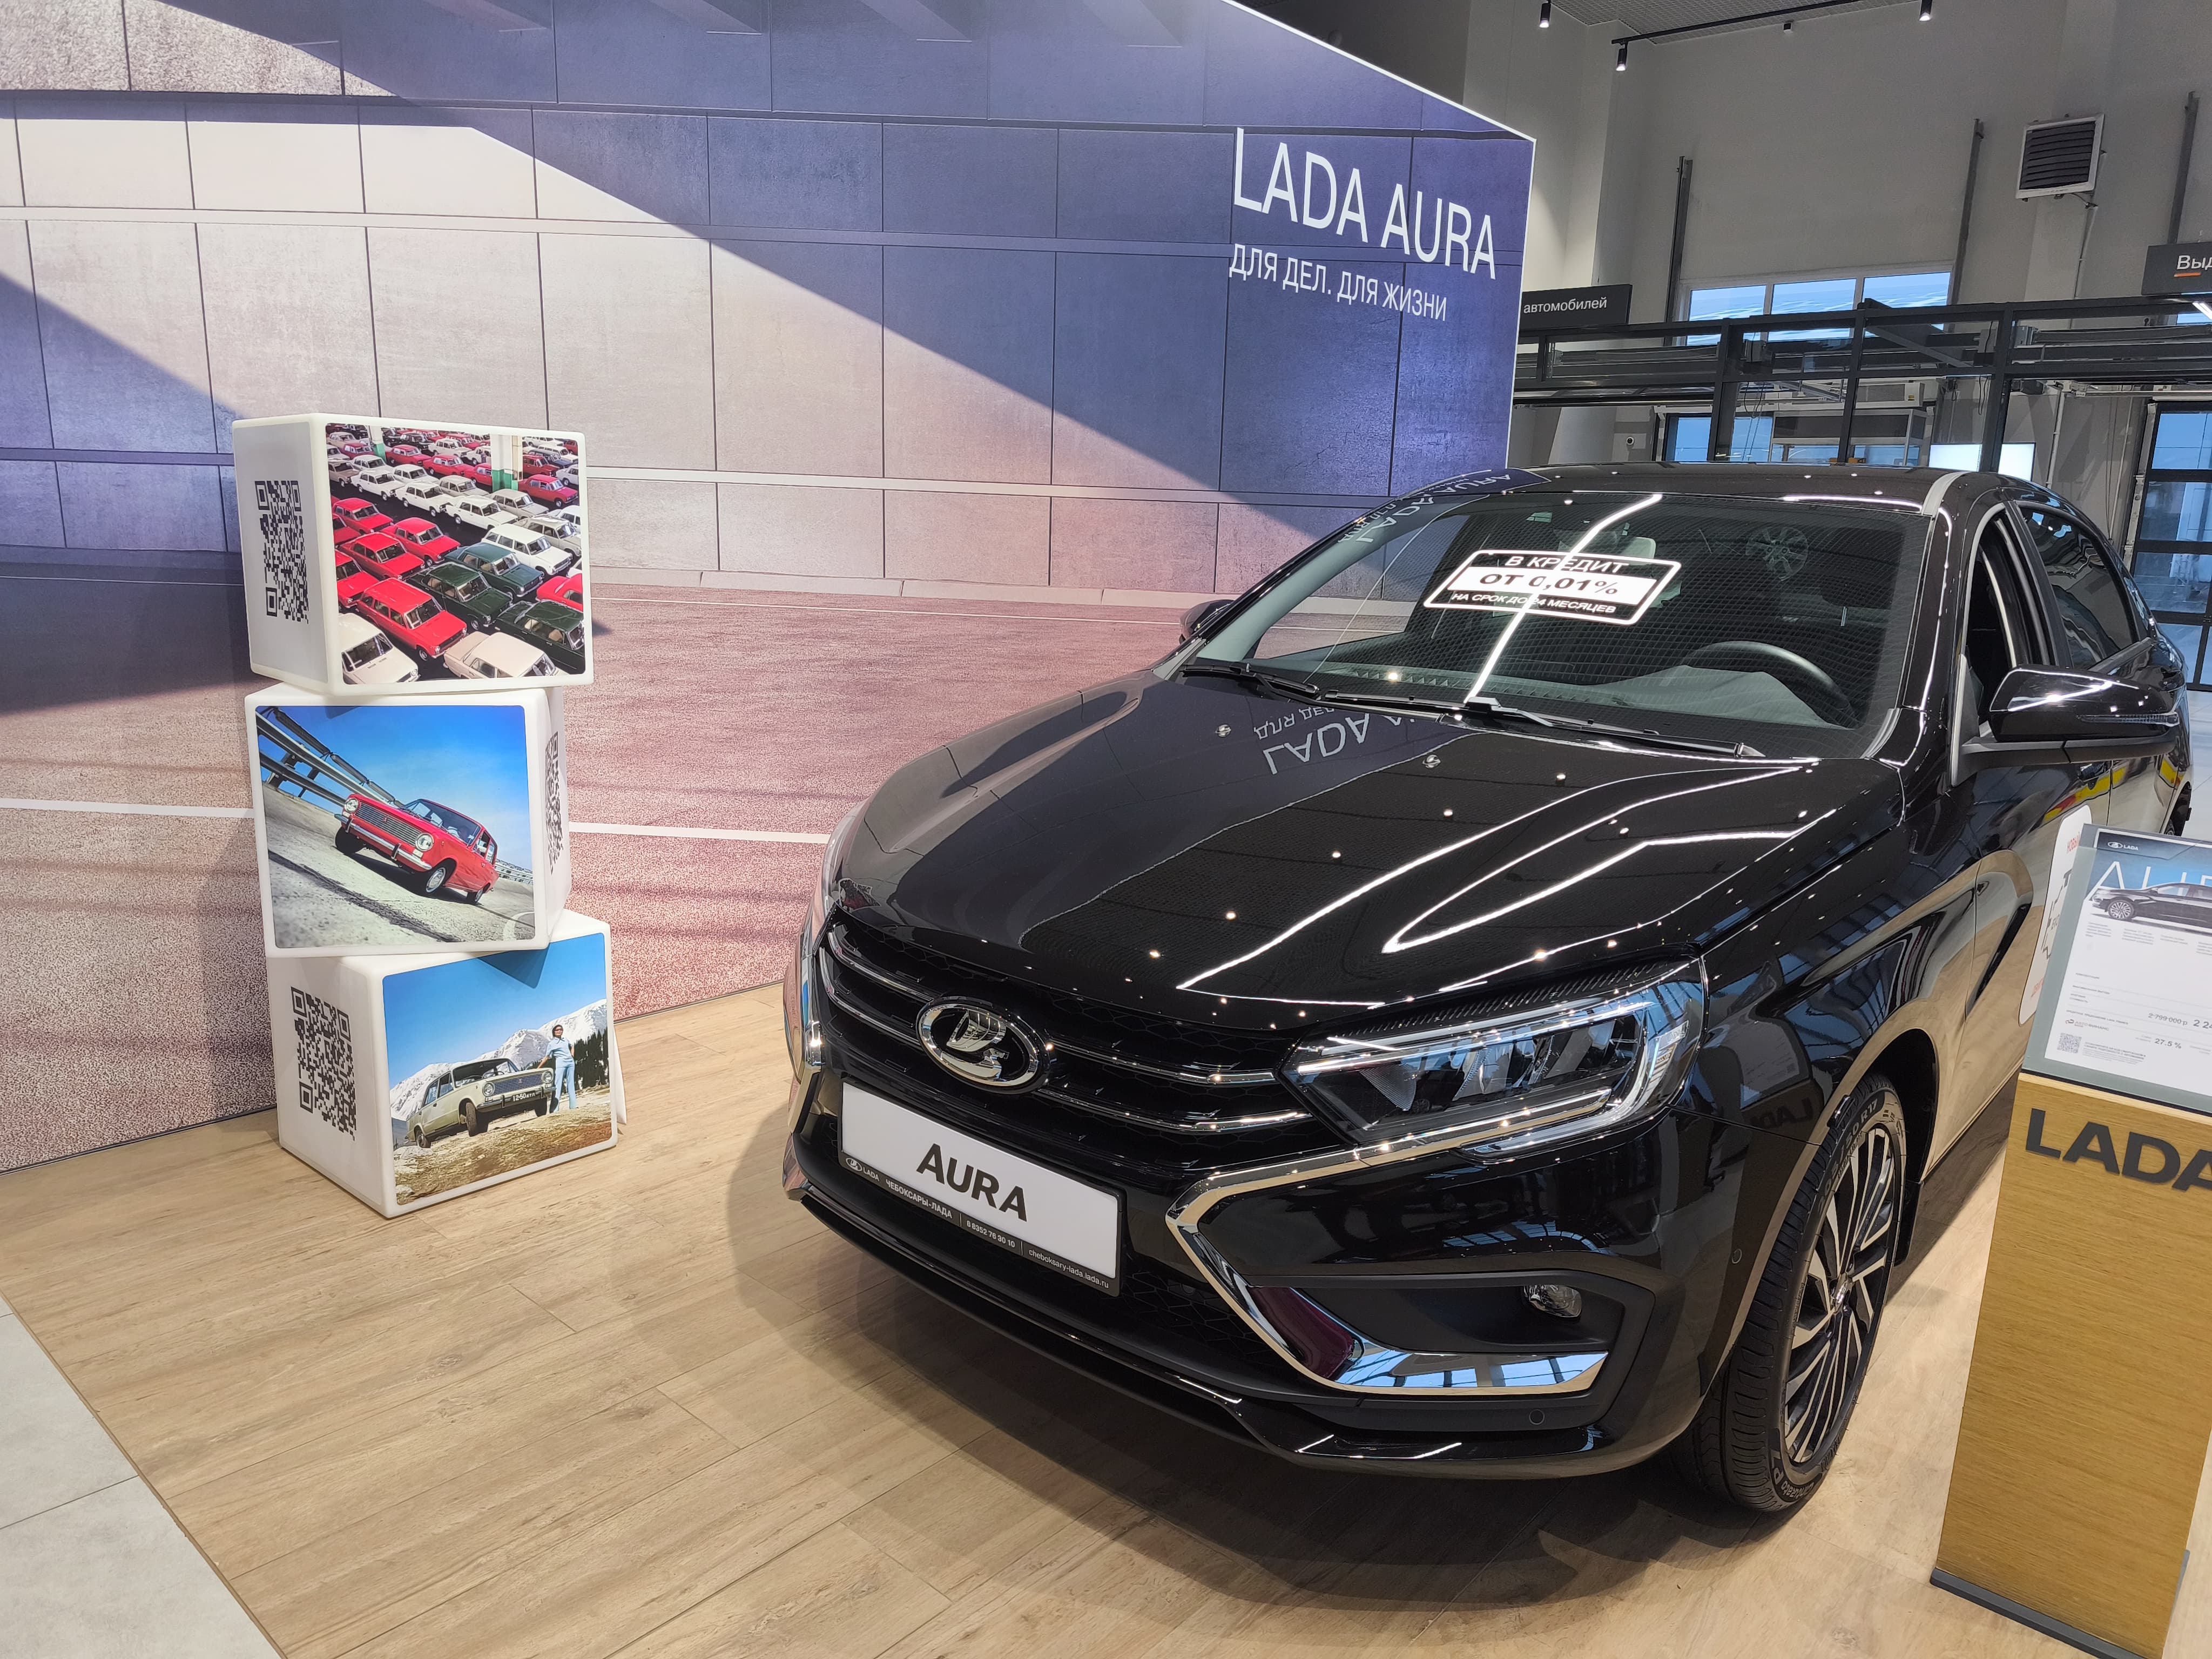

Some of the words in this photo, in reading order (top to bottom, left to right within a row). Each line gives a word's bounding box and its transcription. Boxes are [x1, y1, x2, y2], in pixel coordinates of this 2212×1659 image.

[1234, 127, 1368, 242] LADA
[1380, 184, 1495, 279] AURA
[1229, 243, 1278, 282] ДЛЯ
[1283, 257, 1331, 295] ДЕЛ.
[1337, 271, 1378, 306] ДЛЯ
[1382, 281, 1447, 321] ЖИЗНИ
[1523, 296, 1607, 314] автомобилей
[1479, 574, 1525, 585] ОТ
[1528, 576, 1618, 595] 0,01%
[1505, 556, 1525, 567] В
[1527, 557, 1629, 574] КРЕДИТ
[1472, 594, 1507, 603] СРОК
[1547, 599, 1616, 613] МЕСЯЦЕВ
[1860, 1098, 1878, 1123] R17
[2026, 1108, 2212, 1192] LADA
[916, 1143, 1028, 1222] AURA
[863, 1166, 880, 1182] LADA
[886, 1179, 953, 1219] ЧЕБОКСАРЫ-ЛАДА
[972, 1223, 988, 1236] 8352
[988, 1230, 996, 1239] 76
[997, 1235, 1006, 1244] 30
[1008, 1239, 1015, 1248] 10
[1029, 1249, 1109, 1289] cheboksary-lada.lada.ru
